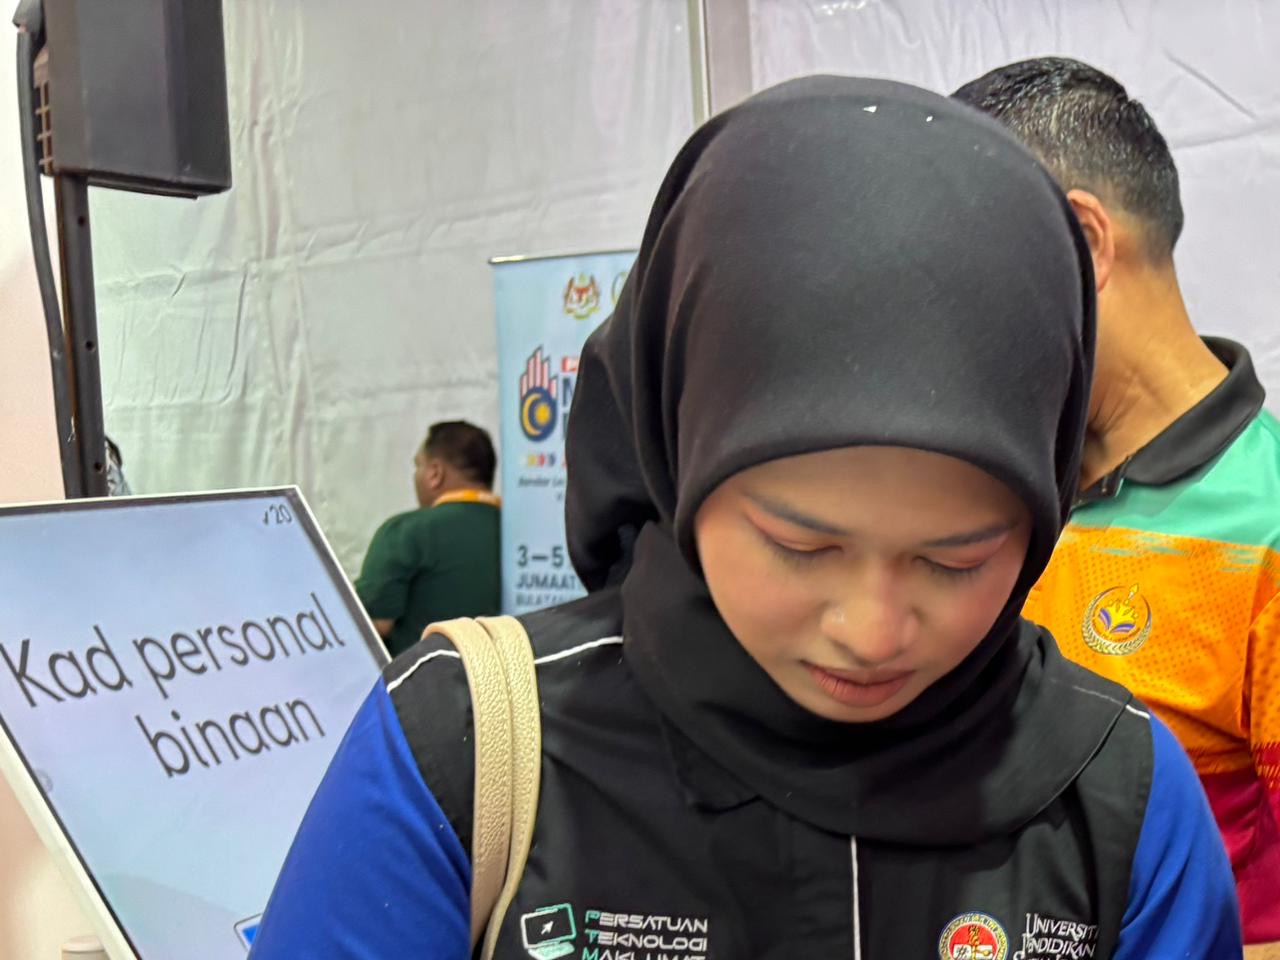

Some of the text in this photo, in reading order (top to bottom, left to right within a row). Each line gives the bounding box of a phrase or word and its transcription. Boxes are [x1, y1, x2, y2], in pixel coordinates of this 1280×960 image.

[517, 574, 576, 590] JUMAAT
[0, 592, 346, 707] Kad personal
[135, 696, 326, 778] binaan
[584, 909, 708, 934] PERSATUAN
[584, 929, 708, 952] TEKNOLOGI
